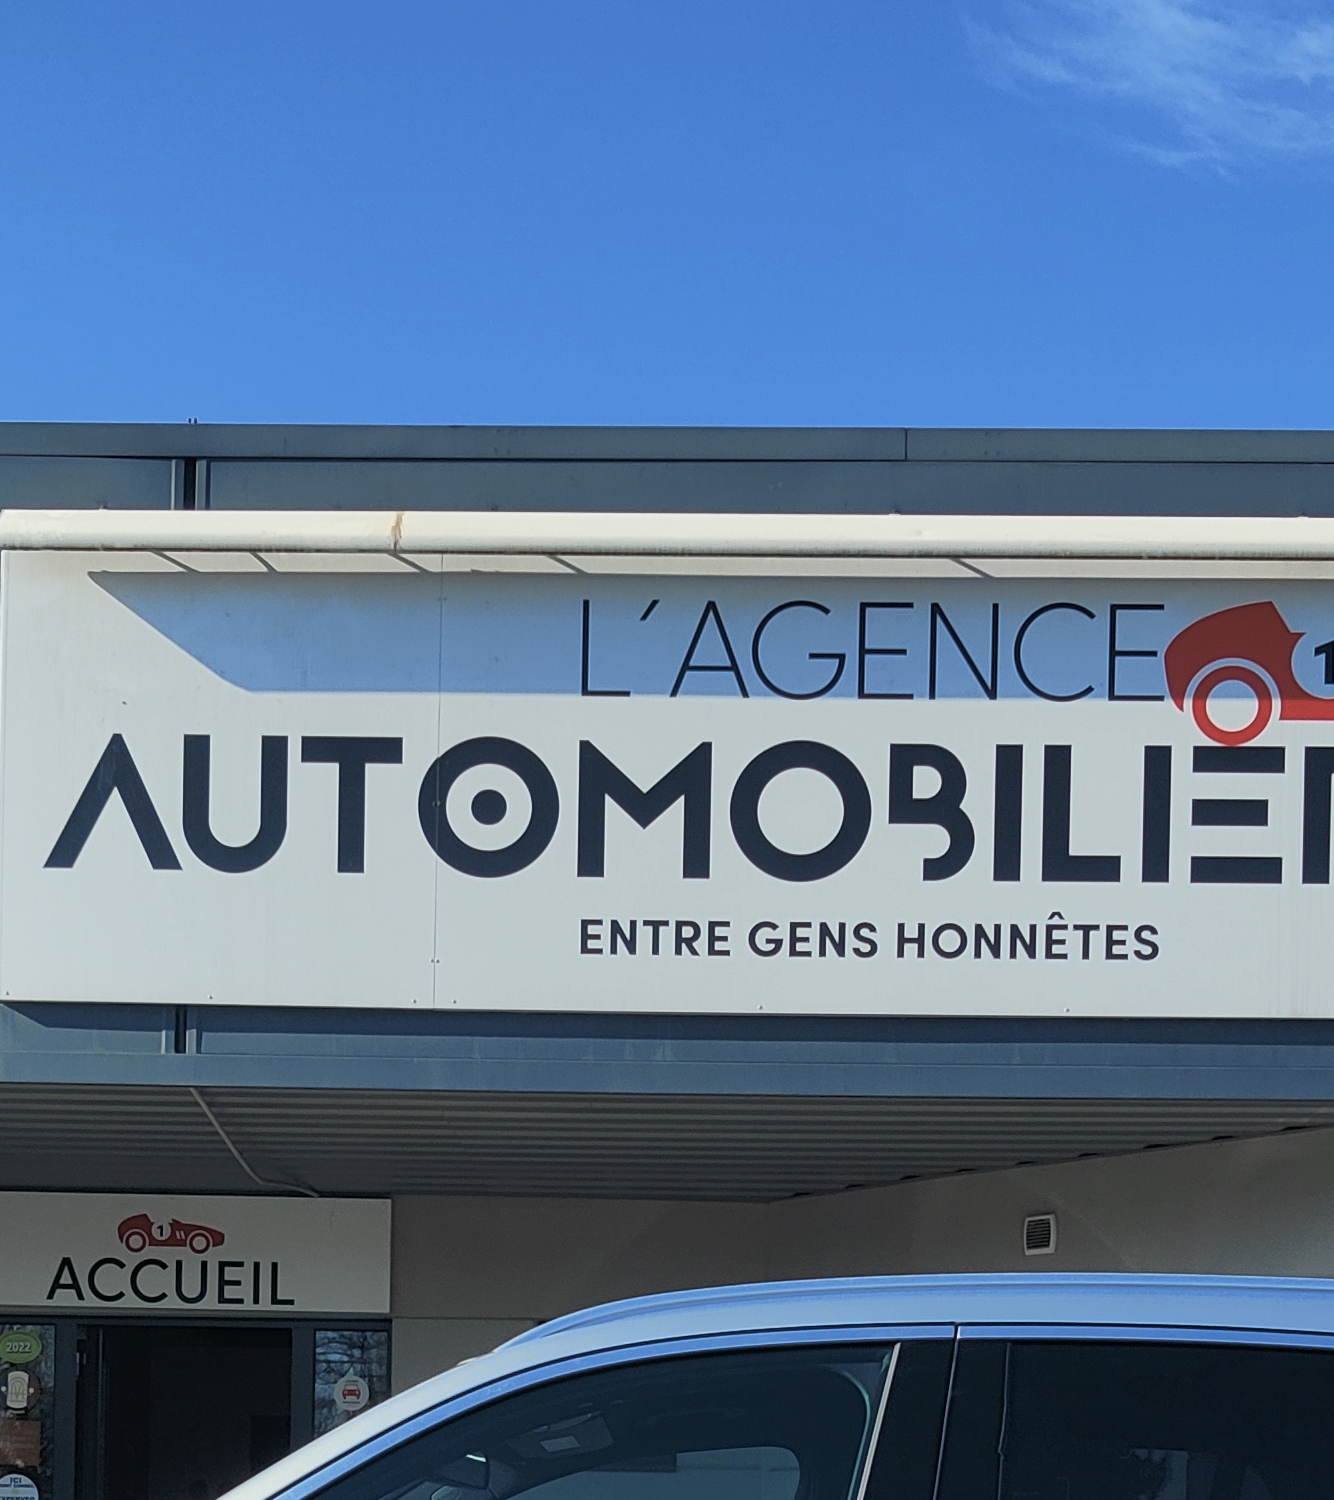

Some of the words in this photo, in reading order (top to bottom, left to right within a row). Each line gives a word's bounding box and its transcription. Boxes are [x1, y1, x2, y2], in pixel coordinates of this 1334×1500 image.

[581, 599, 1165, 702] L'AGENCE
[1314, 640, 1334, 684] 1
[580, 918, 731, 957] ENTRE
[748, 920, 878, 959] GENS
[896, 911, 1160, 961] HONNÊTES
[46, 1256, 295, 1306] ACCUEIL
[6, 1342, 32, 1353] 2022
